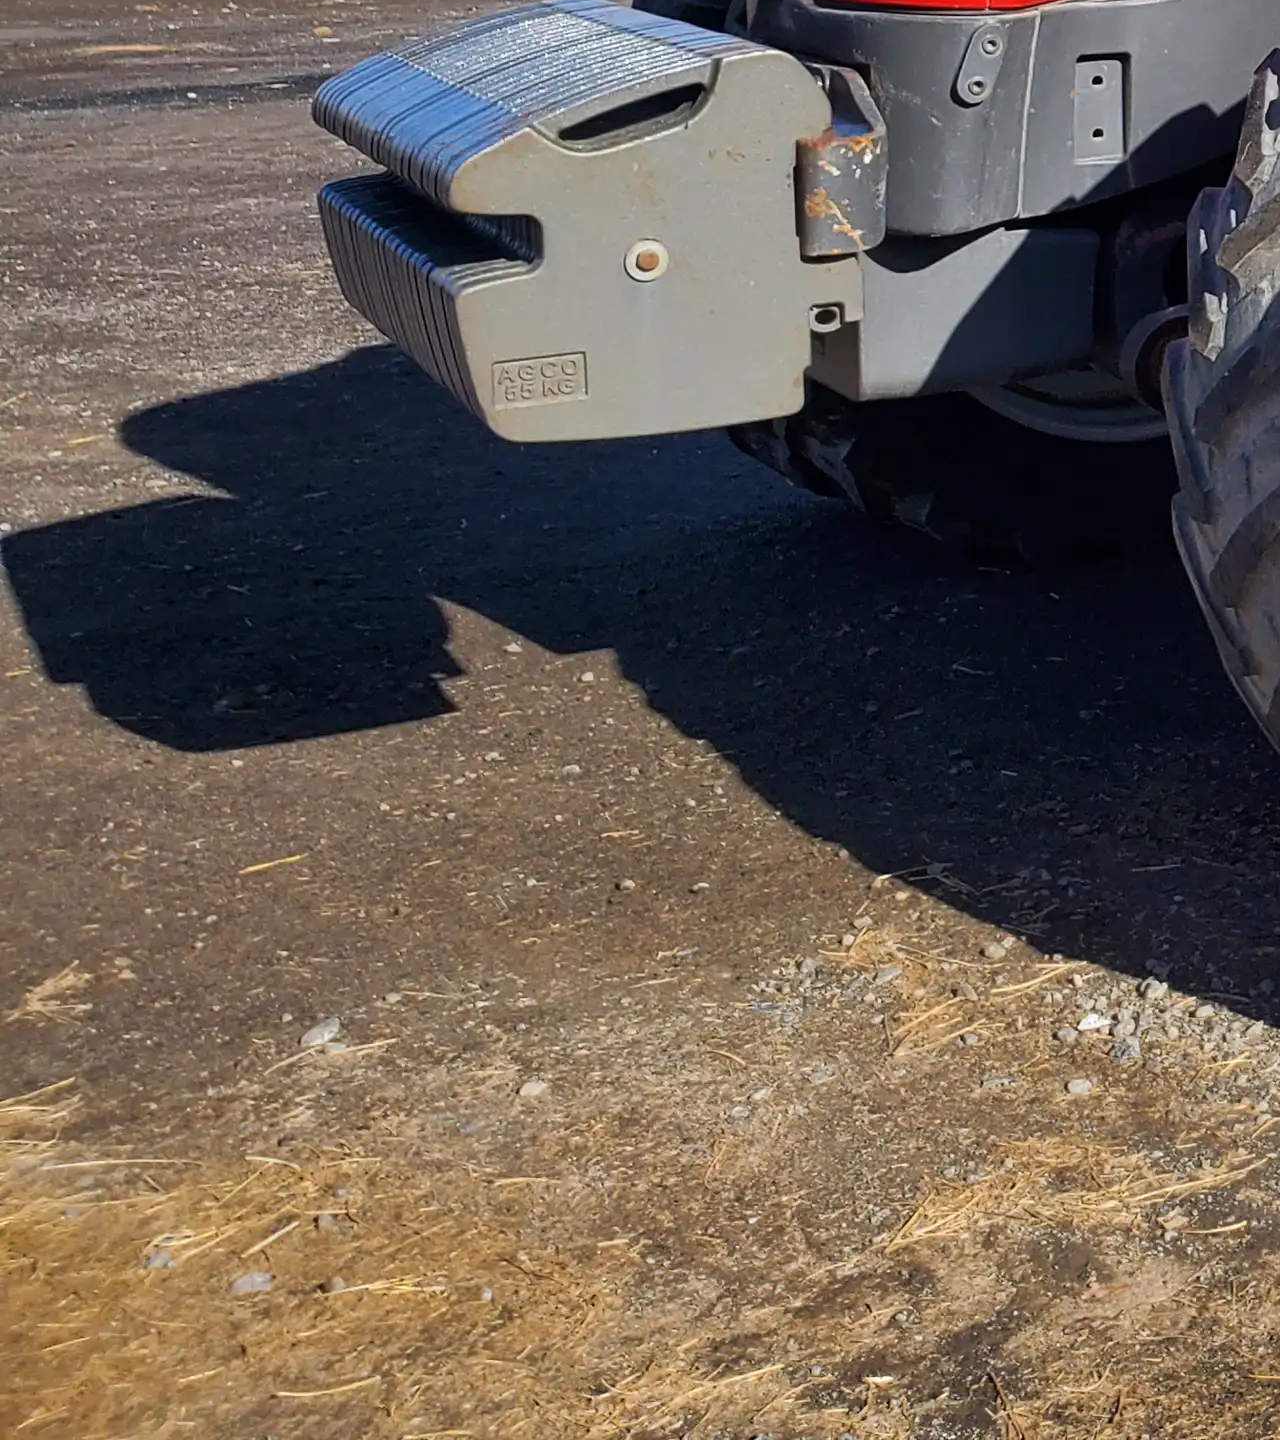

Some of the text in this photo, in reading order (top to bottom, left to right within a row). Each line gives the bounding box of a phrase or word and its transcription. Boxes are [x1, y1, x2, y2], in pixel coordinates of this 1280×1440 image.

[496, 359, 578, 386] AGCO
[504, 378, 576, 402] 55 KG
